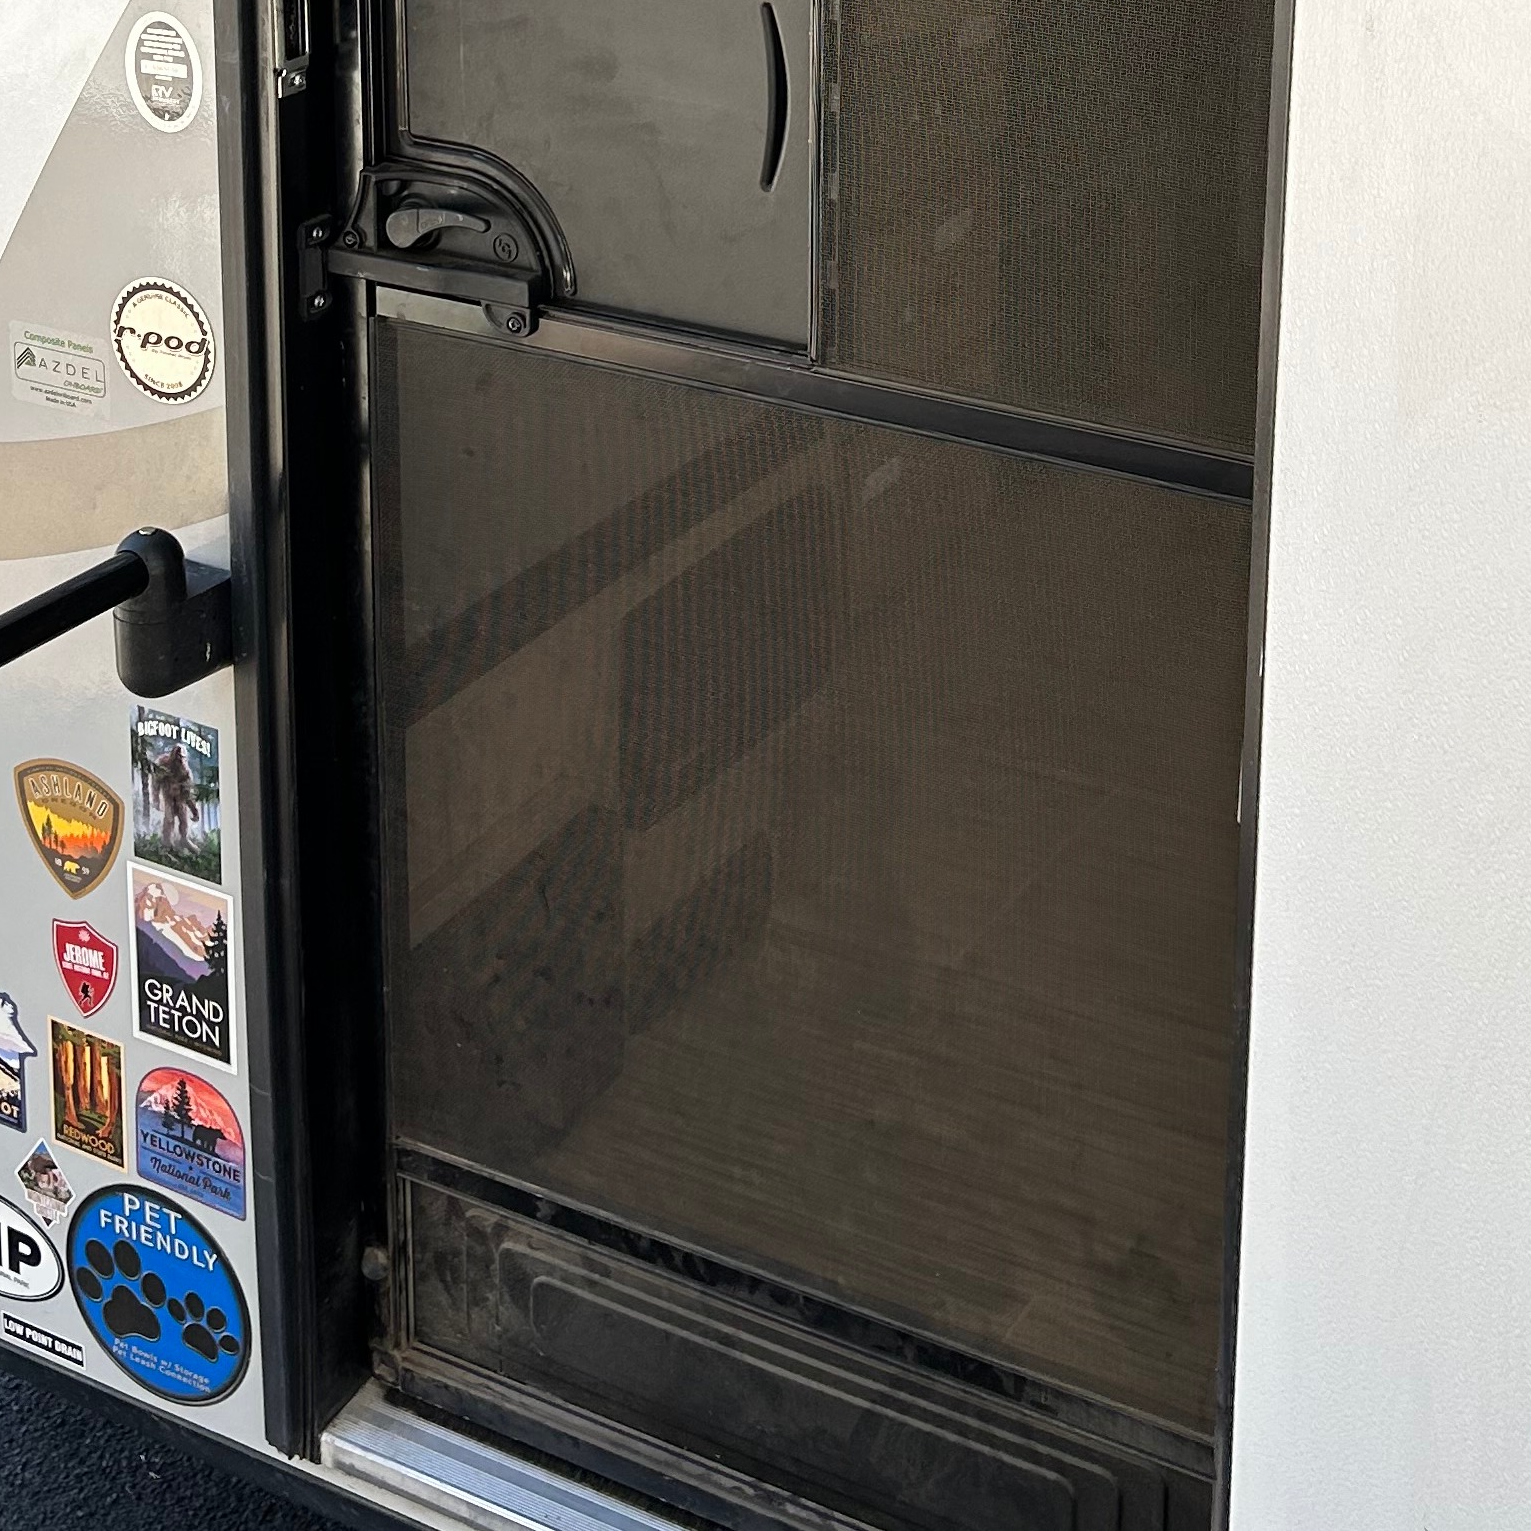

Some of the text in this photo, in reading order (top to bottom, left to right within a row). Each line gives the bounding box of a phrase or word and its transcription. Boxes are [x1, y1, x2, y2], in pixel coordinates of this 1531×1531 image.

[24, 331, 93, 353] Composite Panels
[39, 358, 105, 383] AZDEL
[144, 374, 164, 388] SINCE
[137, 720, 211, 758] BIGFOOT LIVES!
[28, 774, 110, 819] ASHLAND
[63, 943, 105, 971] JEROME
[144, 978, 224, 1023] GRAND
[146, 1000, 220, 1048] TETON
[63, 1123, 115, 1154] REDWOOD
[140, 1129, 241, 1183] YELLOWSTONE
[150, 1156, 200, 1187] National
[201, 1176, 232, 1201] Park
[123, 1192, 182, 1234] PET
[100, 1209, 218, 1271] FRIENDLY
[4, 1318, 83, 1361] LOW POINT DRAIN
[158, 1365, 211, 1393] Connection
[174, 1364, 210, 1384] Storage
